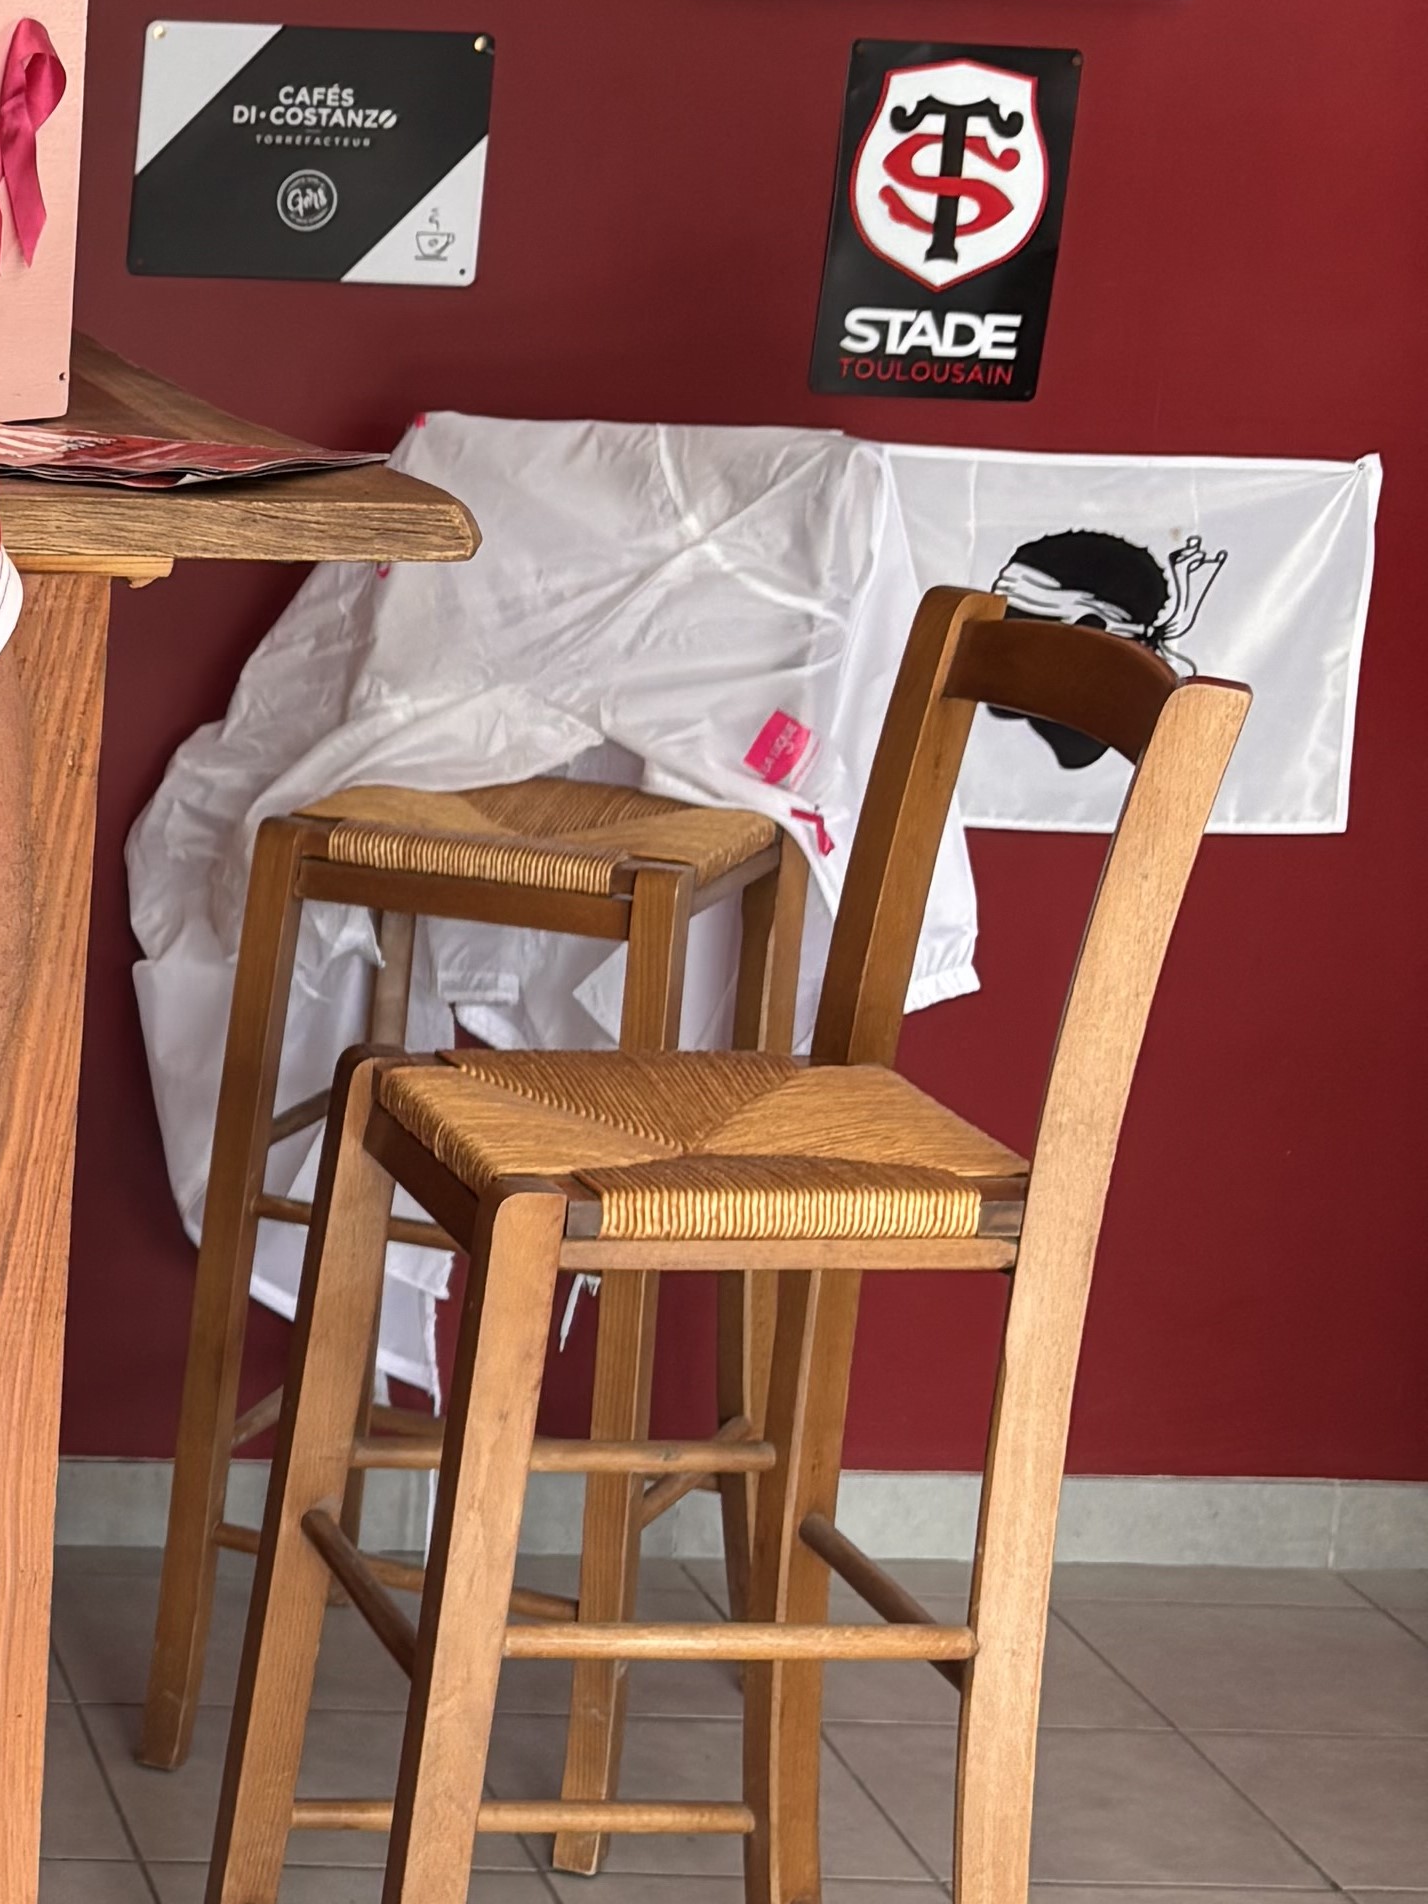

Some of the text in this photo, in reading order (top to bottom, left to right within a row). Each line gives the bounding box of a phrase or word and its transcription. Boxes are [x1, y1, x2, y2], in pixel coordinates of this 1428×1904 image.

[278, 82, 355, 107] CAFÉS
[255, 132, 372, 149] TORRÉFACTEUR
[839, 305, 1023, 361] STADE
[837, 357, 1016, 386] TOULOUSAIN
